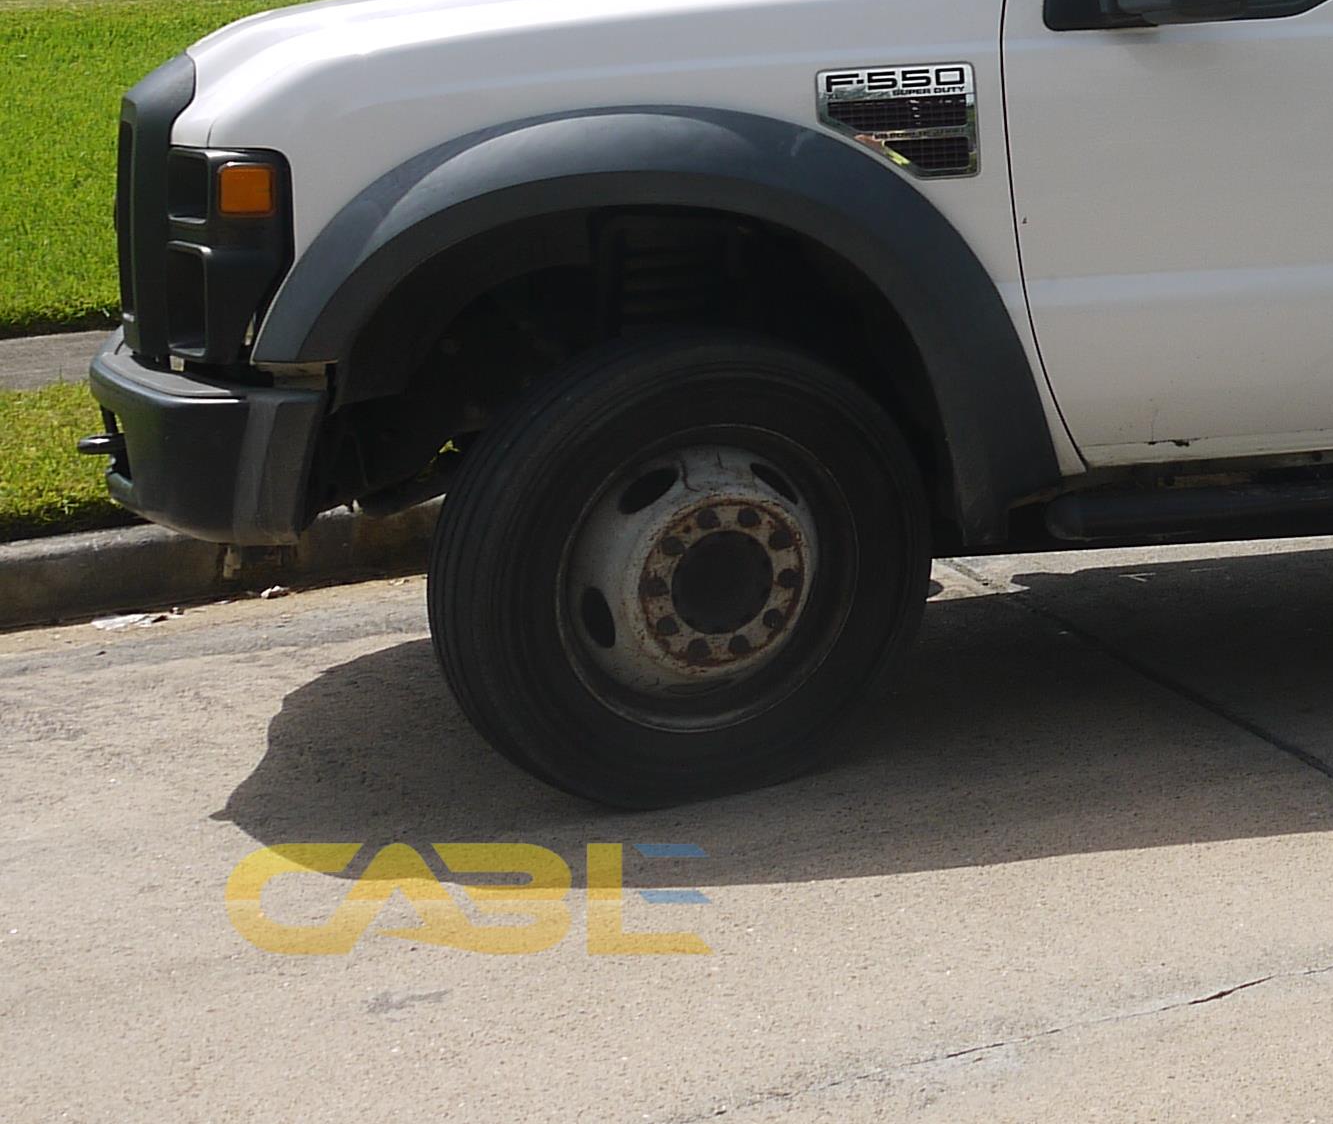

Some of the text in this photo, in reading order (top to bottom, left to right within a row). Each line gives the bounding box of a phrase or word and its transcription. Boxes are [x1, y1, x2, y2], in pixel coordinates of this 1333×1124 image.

[826, 67, 965, 93] F-550
[892, 86, 966, 96] SUPER DUTY
